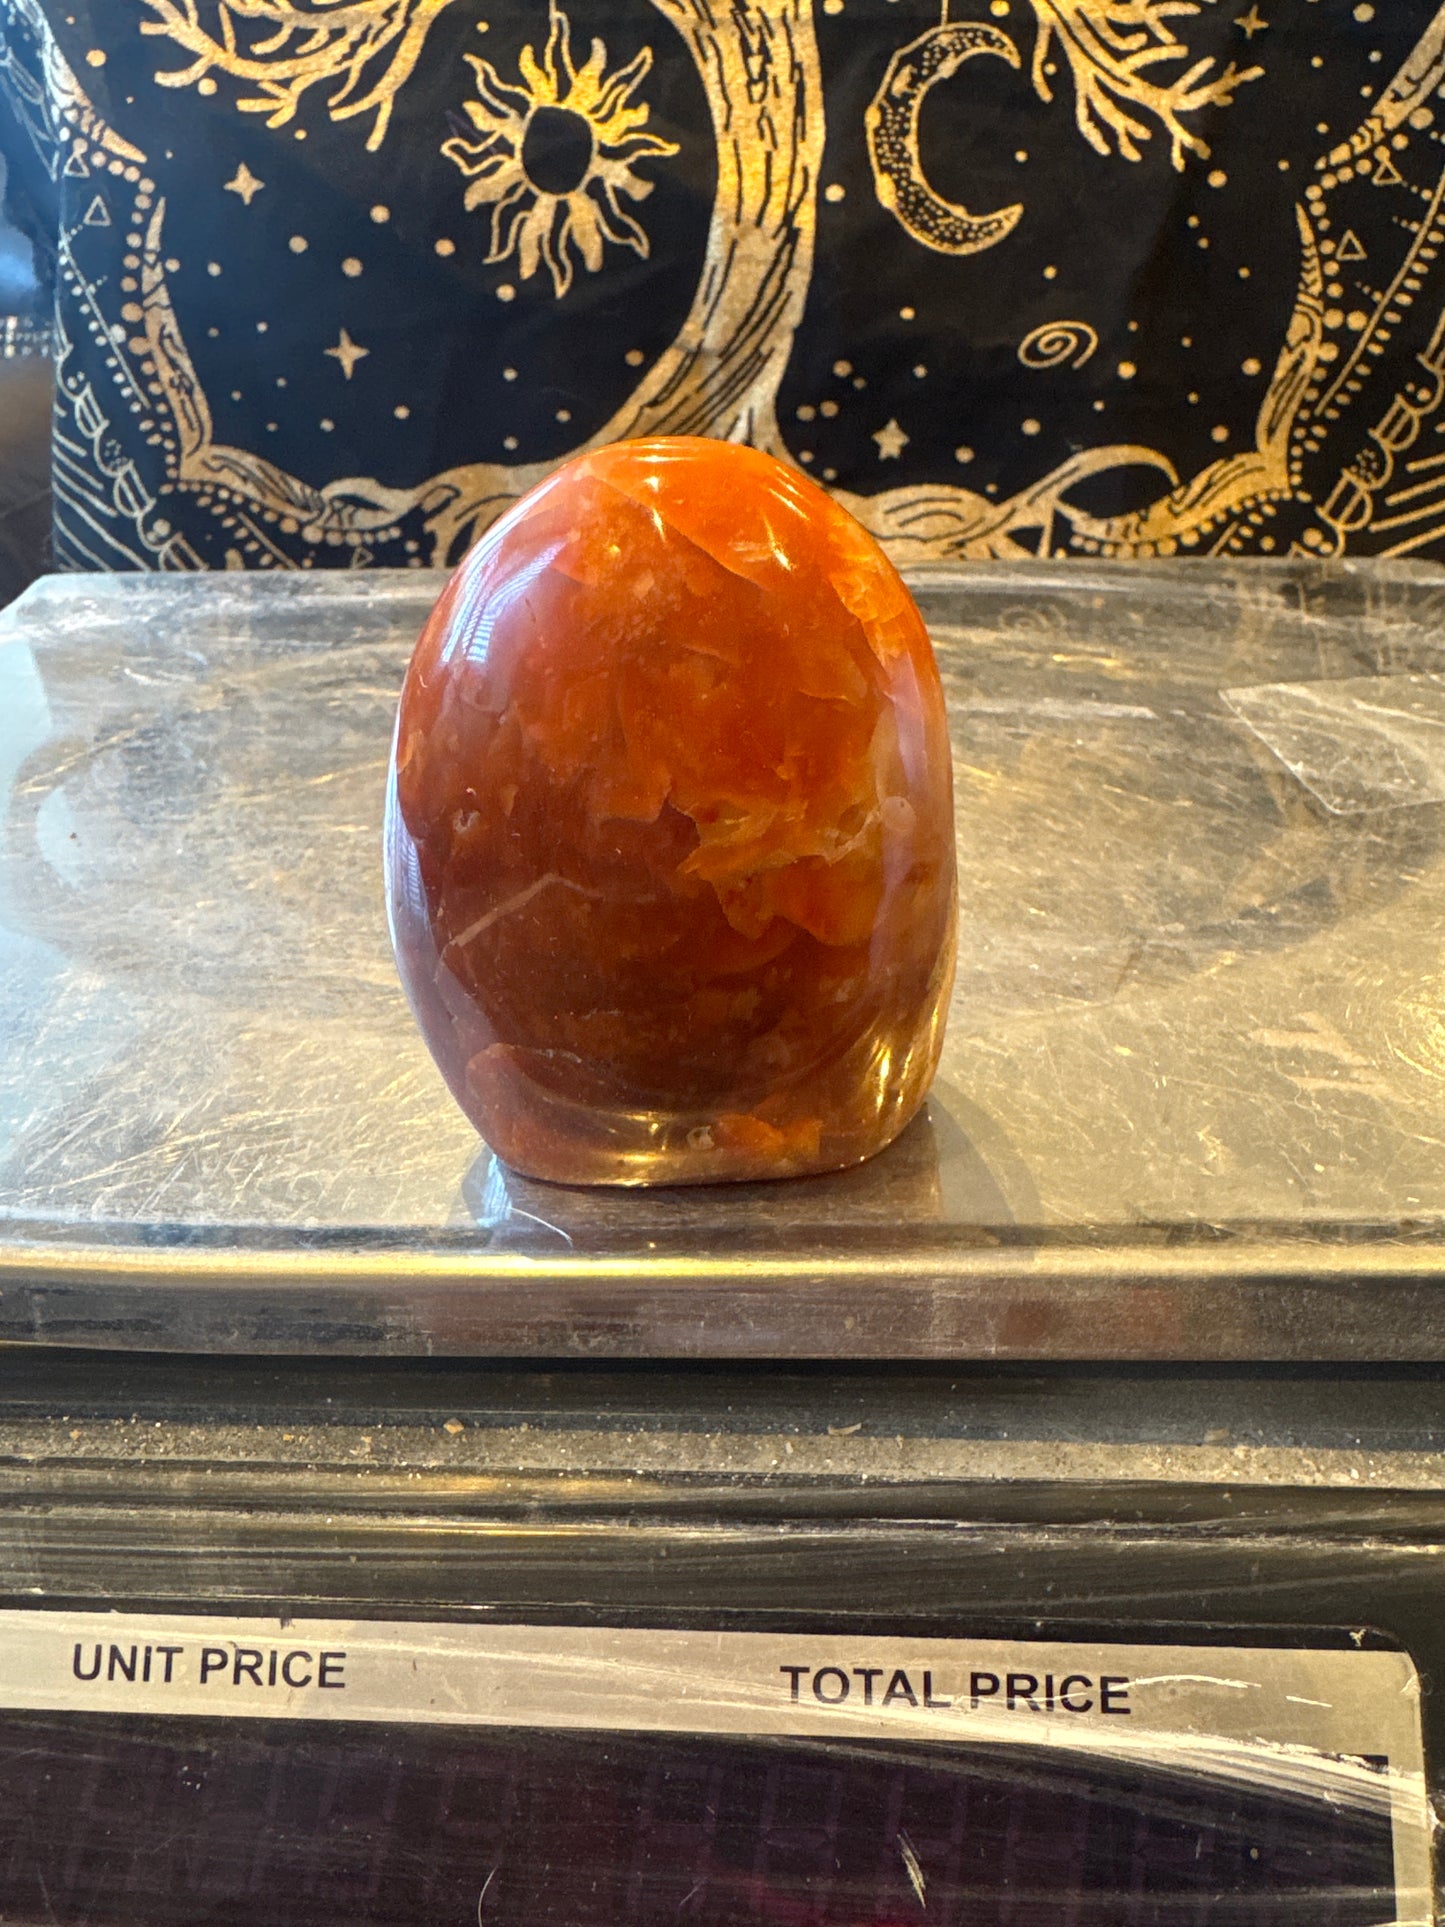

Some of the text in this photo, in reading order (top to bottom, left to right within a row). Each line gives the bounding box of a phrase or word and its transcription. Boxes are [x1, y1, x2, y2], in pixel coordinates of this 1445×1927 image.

[73, 1643, 347, 1688] UNIT PRICE
[780, 1665, 1132, 1714] TOTAL PRICE
